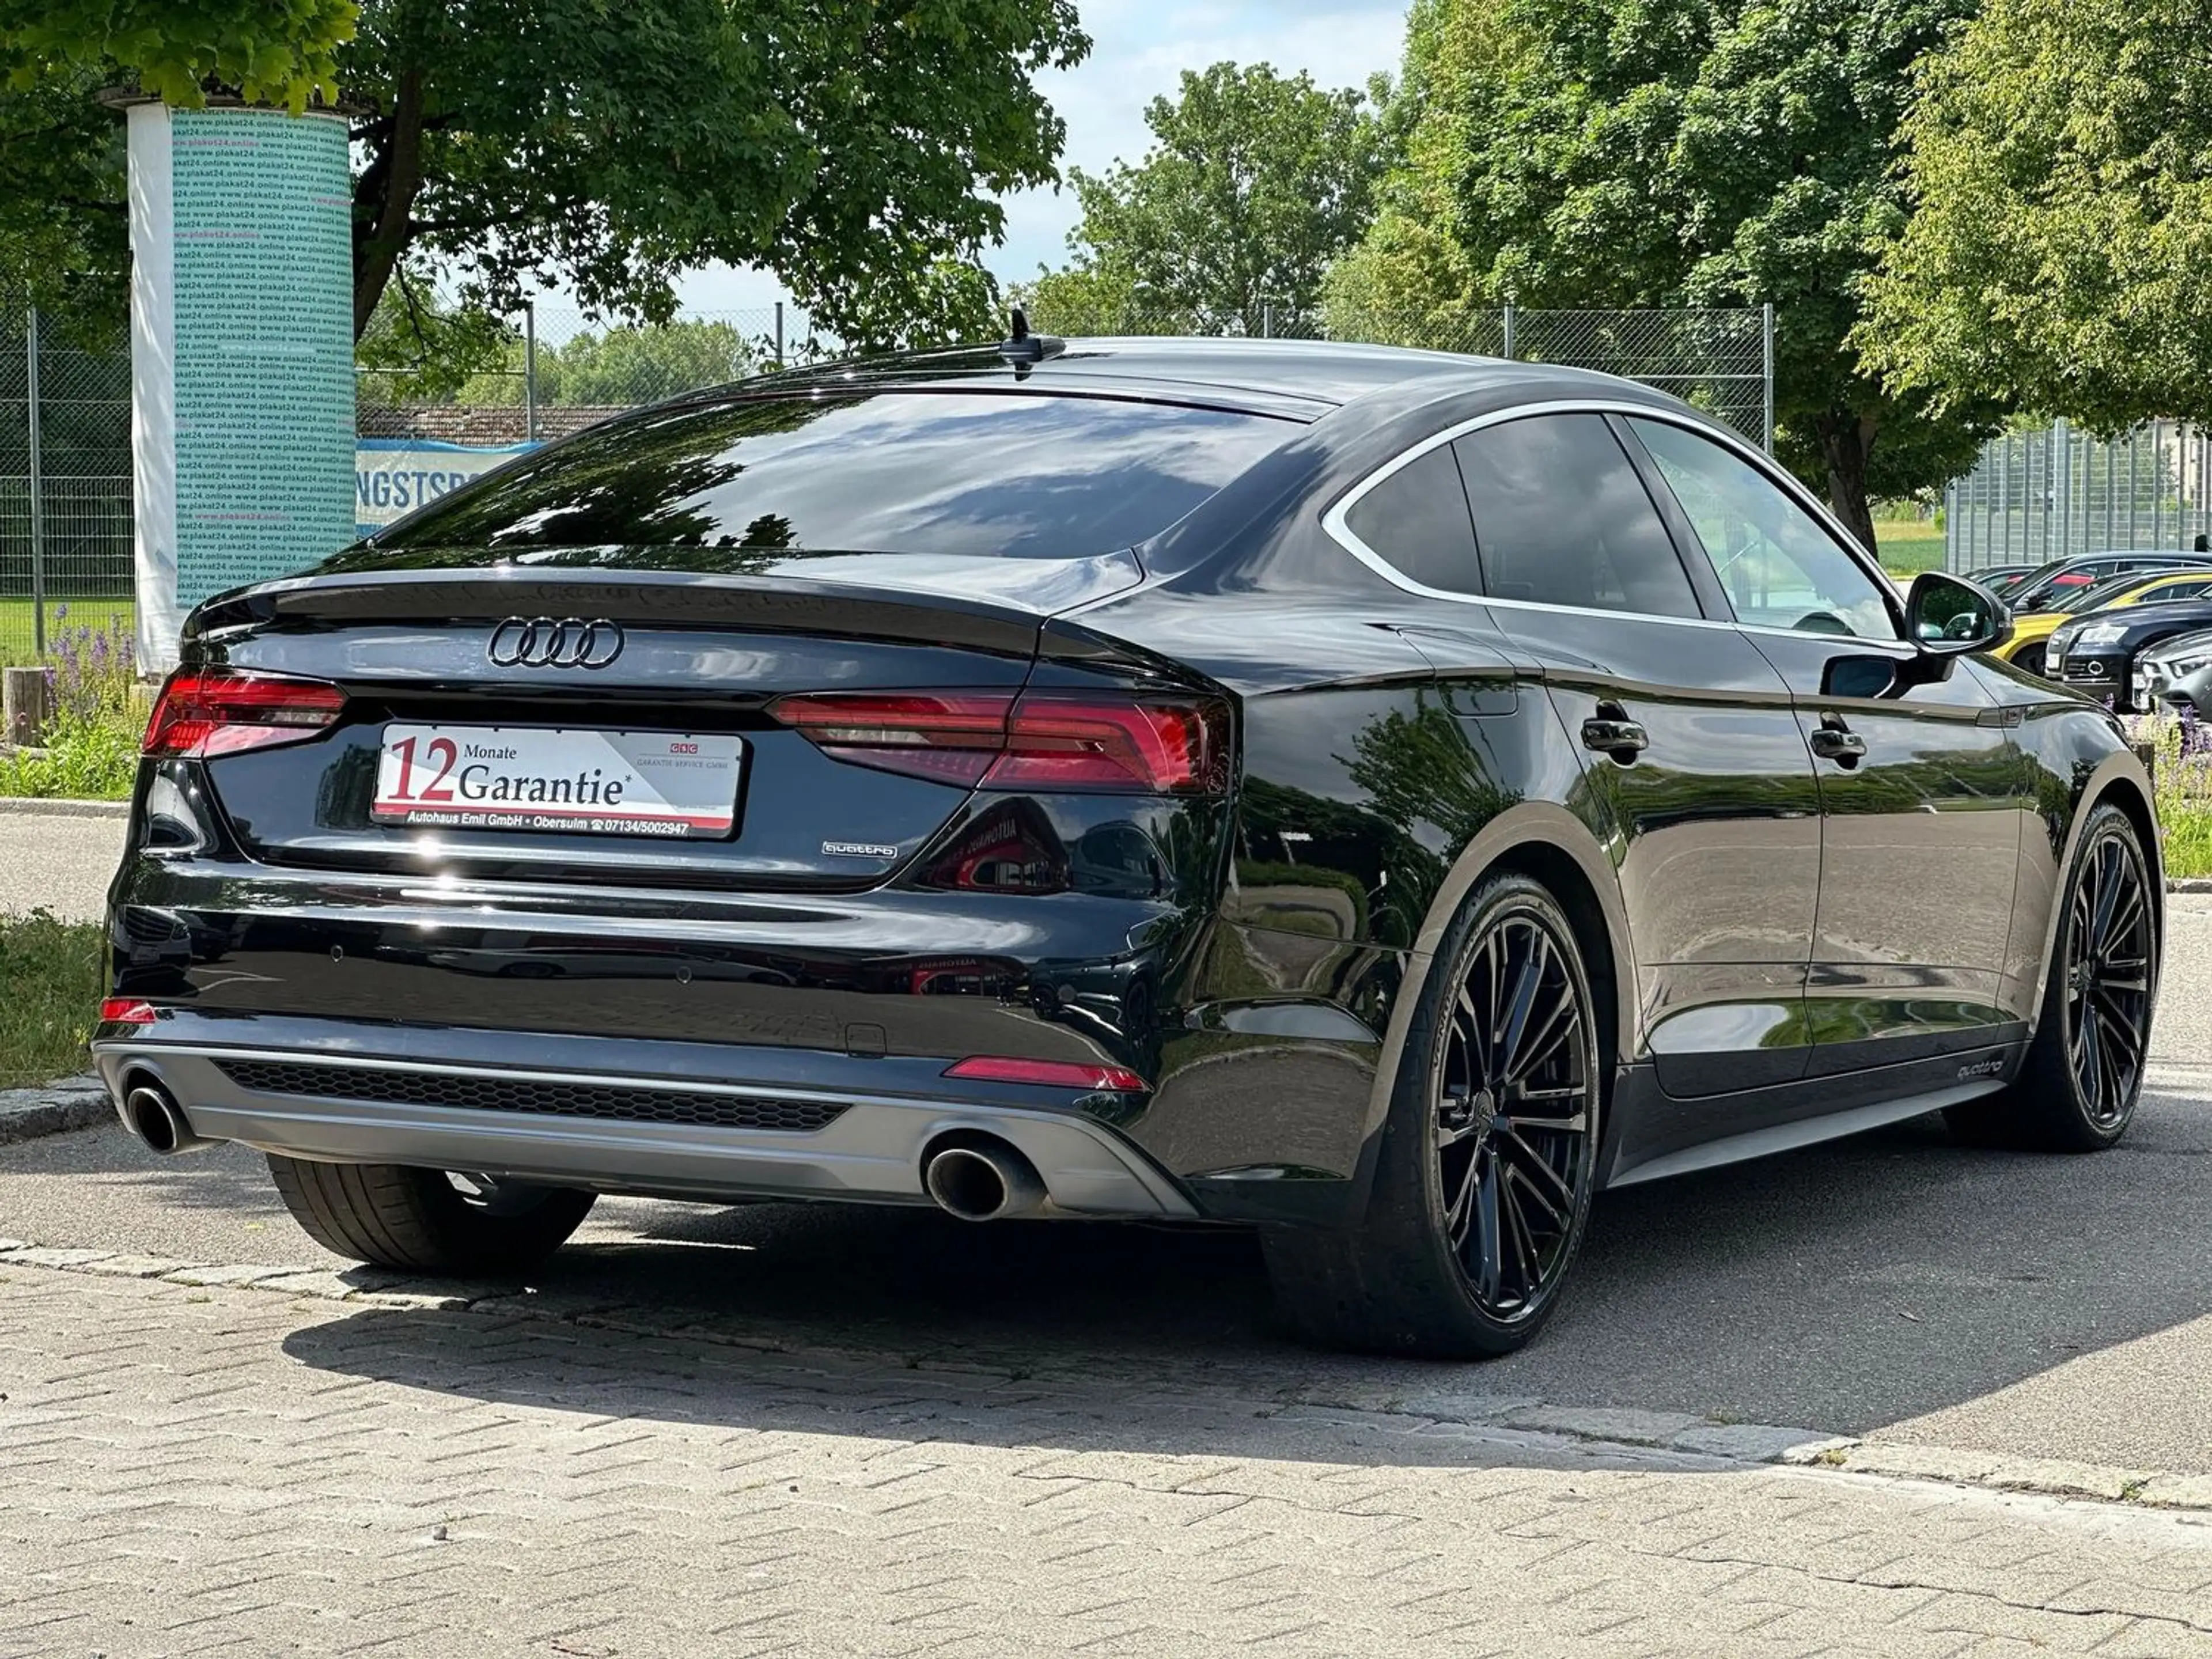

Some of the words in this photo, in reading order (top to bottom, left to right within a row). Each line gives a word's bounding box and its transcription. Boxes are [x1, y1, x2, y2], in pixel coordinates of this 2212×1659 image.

[464, 744, 517, 759] Monate
[388, 736, 458, 802] 12
[407, 811, 459, 823] Autohaus
[462, 813, 484, 824] Emil
[488, 814, 522, 827] GmbH
[533, 816, 586, 830] Obersulm
[605, 820, 690, 835] 07134/5002947
[824, 843, 895, 857] quattro
[1957, 1060, 2005, 1080] quattro
